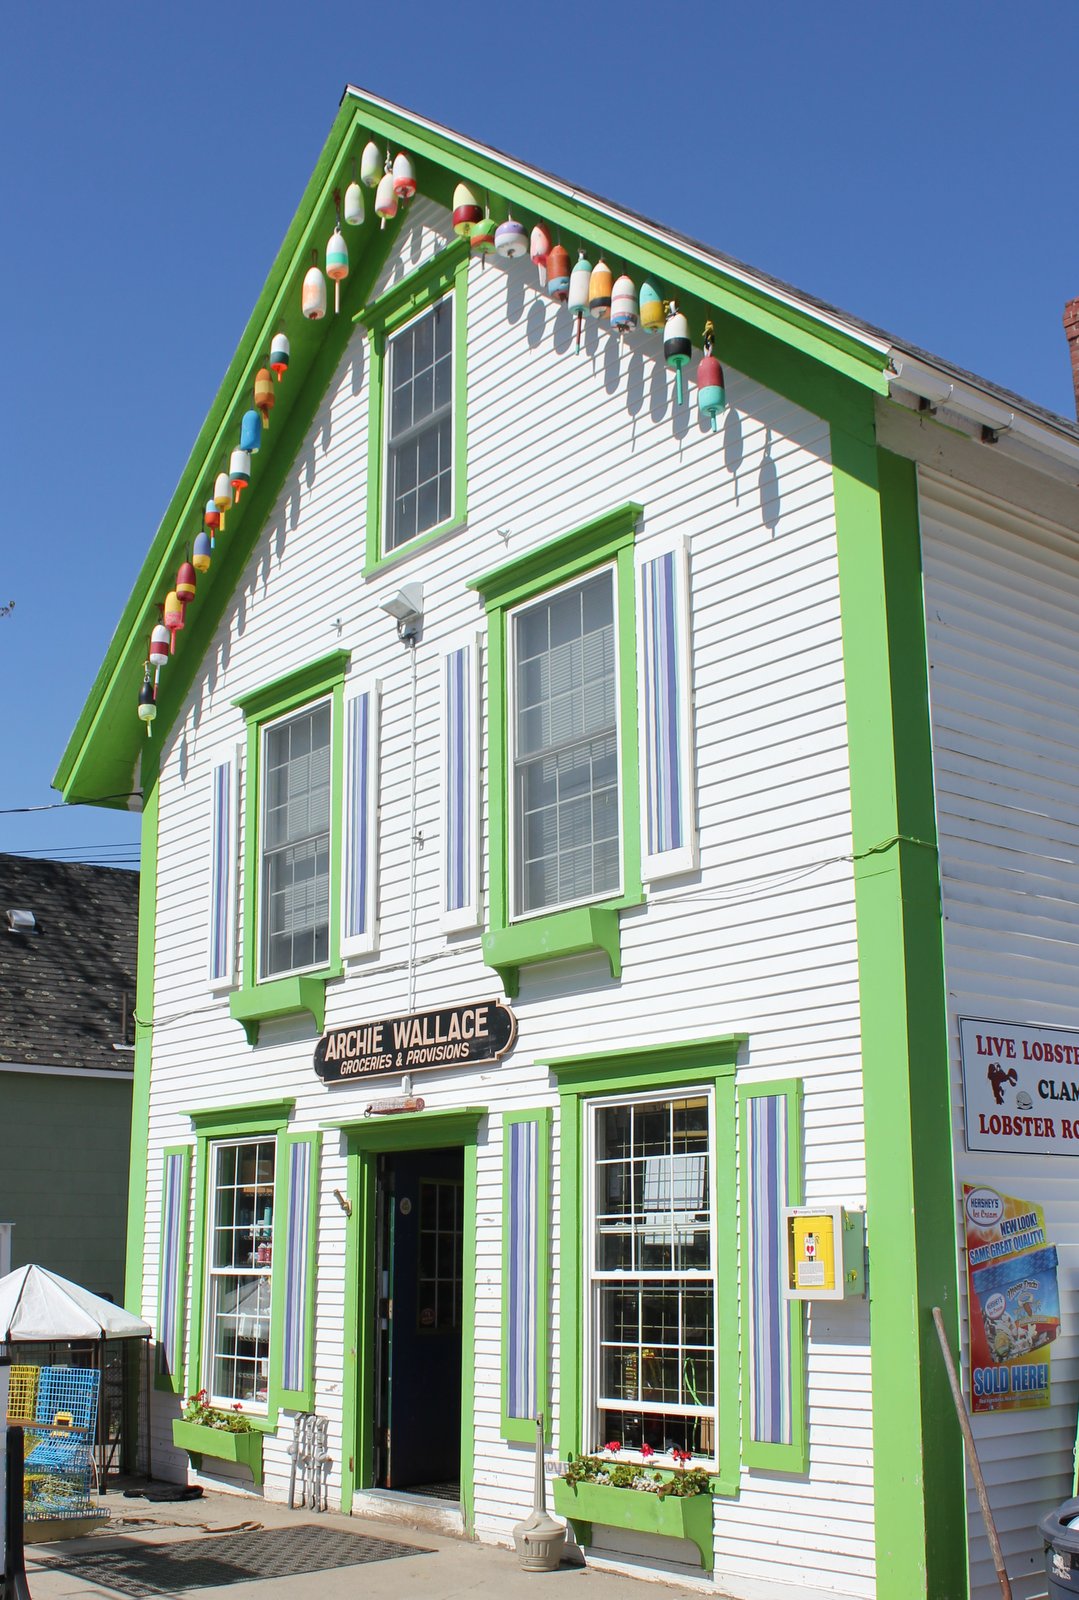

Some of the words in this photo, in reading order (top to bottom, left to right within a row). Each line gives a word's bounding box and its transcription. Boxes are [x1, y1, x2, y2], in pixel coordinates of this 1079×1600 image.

[325, 1025, 384, 1061] ARCHIE
[393, 1007, 489, 1050] WALLACE
[976, 1035, 1016, 1058] LIVE
[340, 1055, 392, 1075] GROCERIES
[395, 1052, 403, 1067] &
[406, 1042, 470, 1065] PROVISIONS
[979, 1113, 1056, 1138] LOBSTER
[970, 1198, 999, 1208] HERSHEY'S
[1000, 1219, 1017, 1236] NEW
[1017, 1212, 1037, 1231] LOOK!
[970, 1245, 991, 1265] SAME
[990, 1239, 1013, 1259] GREAT
[1014, 1229, 1044, 1252] QUALITY!
[974, 1367, 1009, 1395] SOLD
[1012, 1364, 1048, 1391] HERE!
